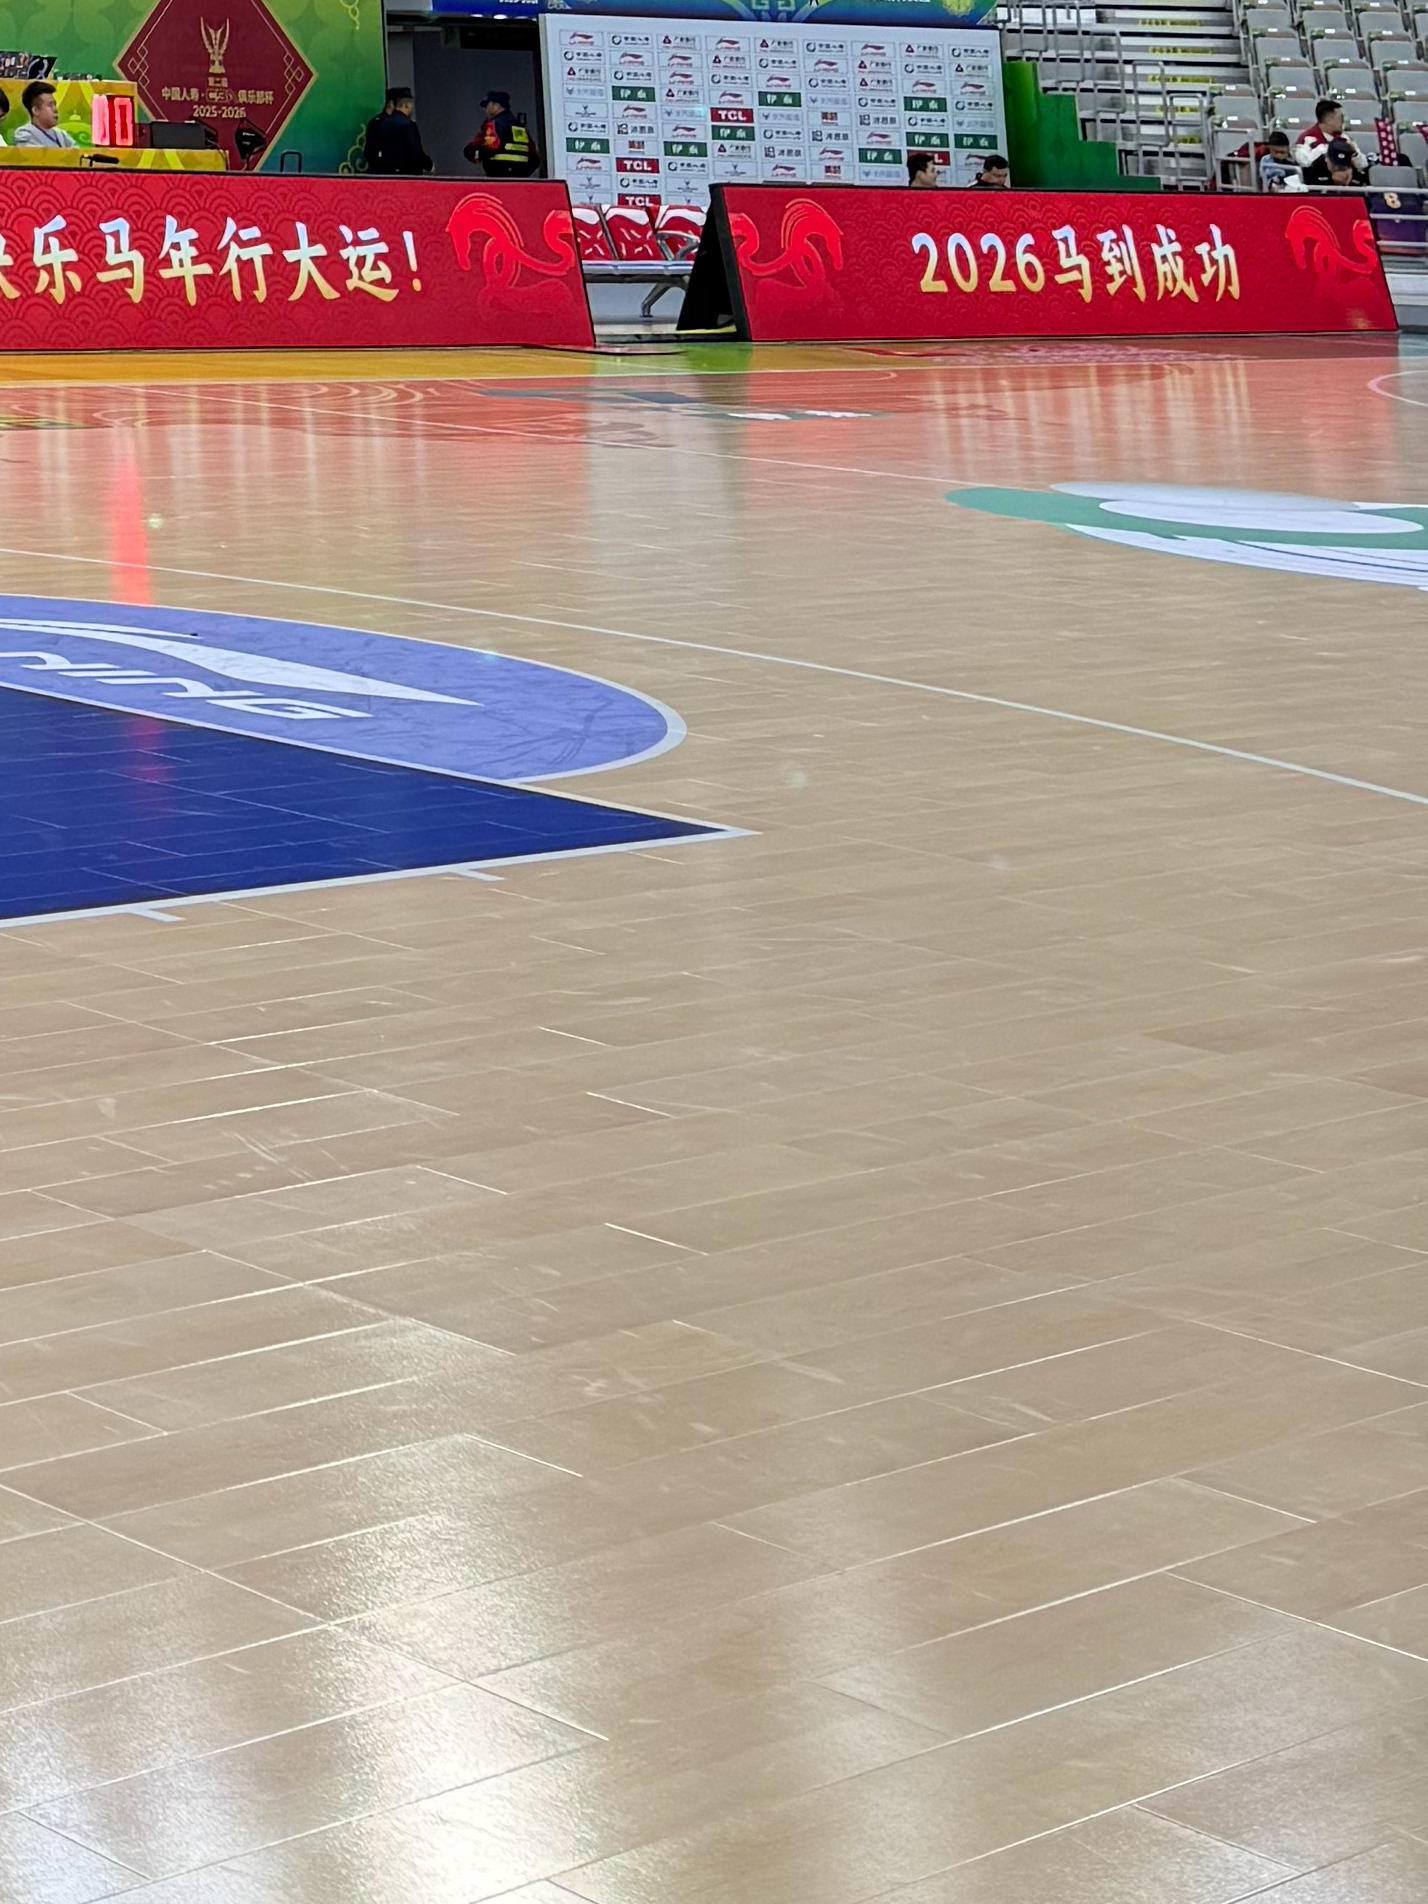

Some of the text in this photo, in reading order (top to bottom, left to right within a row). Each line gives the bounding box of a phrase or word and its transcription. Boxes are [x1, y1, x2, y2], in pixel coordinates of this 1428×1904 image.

[193, 105, 247, 118] 2025-2026
[718, 110, 747, 121] TCL
[623, 160, 652, 171] TCL
